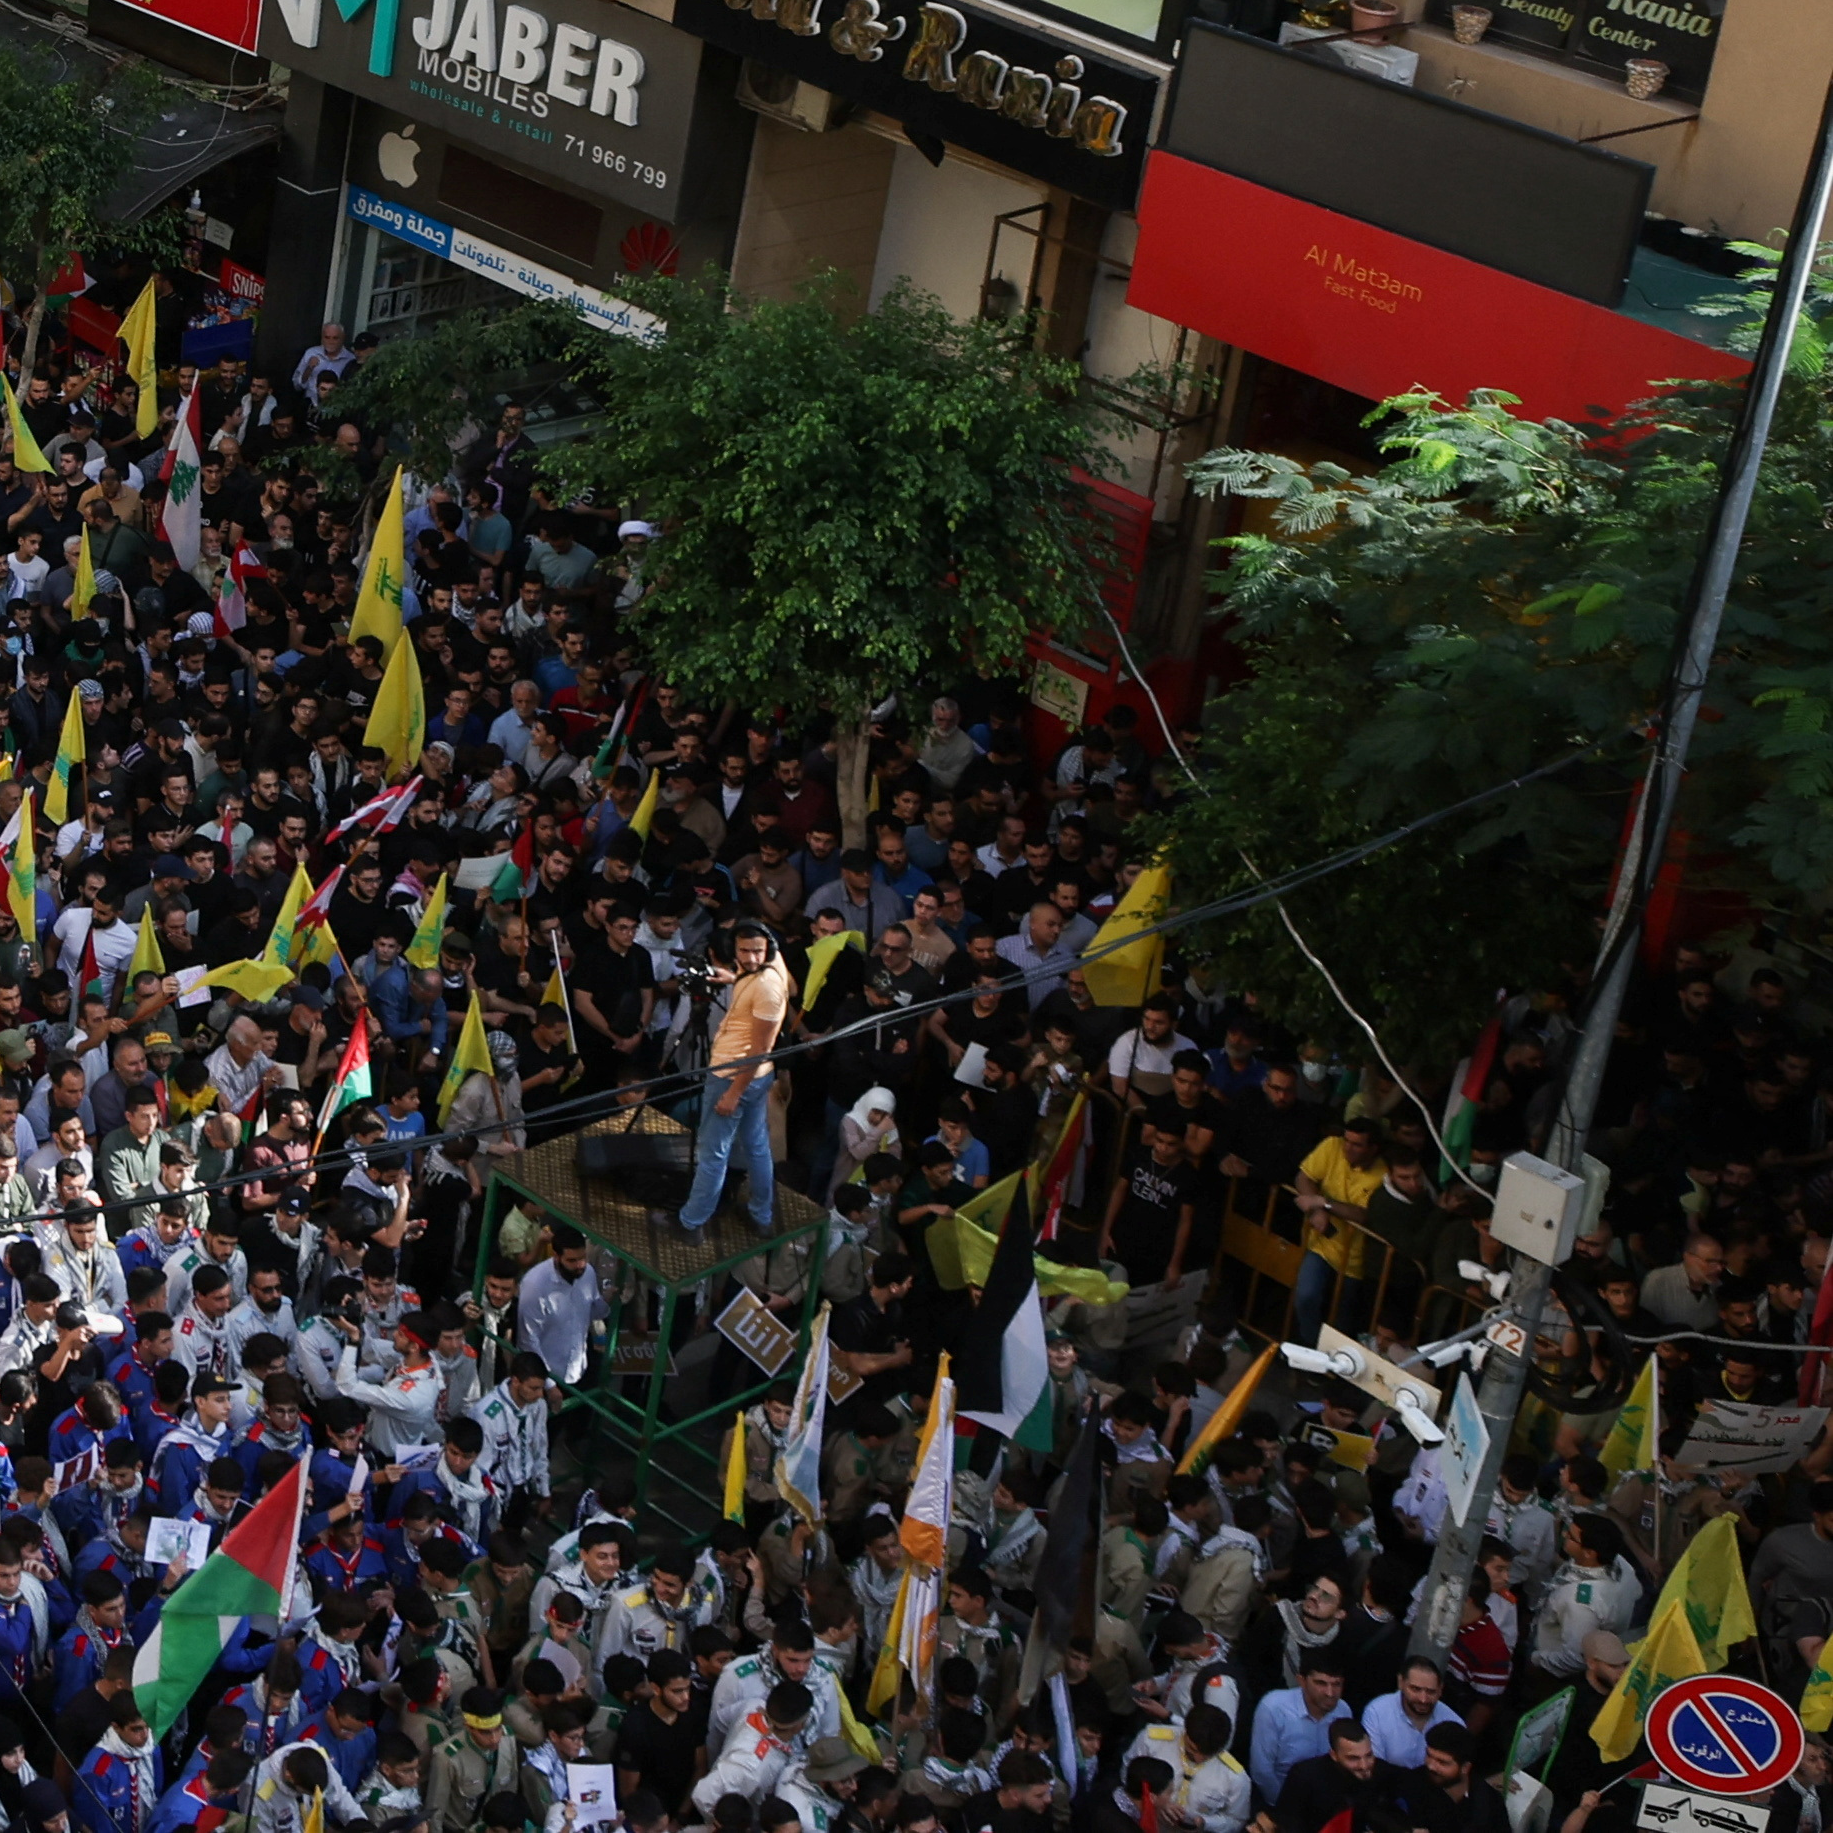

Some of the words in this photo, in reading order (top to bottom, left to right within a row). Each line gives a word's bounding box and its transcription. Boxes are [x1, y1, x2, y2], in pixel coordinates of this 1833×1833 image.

[1588, 16, 1658, 52] Center
[417, 48, 550, 119] MOBILES
[902, 1, 1128, 157] Rania
[409, 77, 485, 118] wholesale
[491, 108, 501, 125] &
[508, 117, 553, 145] retail
[563, 134, 586, 158] 71
[592, 145, 627, 175] 966
[633, 161, 667, 190] 799
[352, 194, 401, 231] ومفرق
[405, 213, 447, 247] جملة
[453, 238, 505, 273] تلفونات
[1303, 244, 1328, 268] Al
[1333, 253, 1423, 303] Mat3am
[1324, 275, 1355, 300] Fast
[1359, 288, 1398, 315] Food
[1752, 1407, 1775, 1430] 5
[1773, 1414, 1802, 1426] فجر
[1724, 1707, 1768, 1727] ممنوع
[1680, 1740, 1723, 1762] الوقوف
